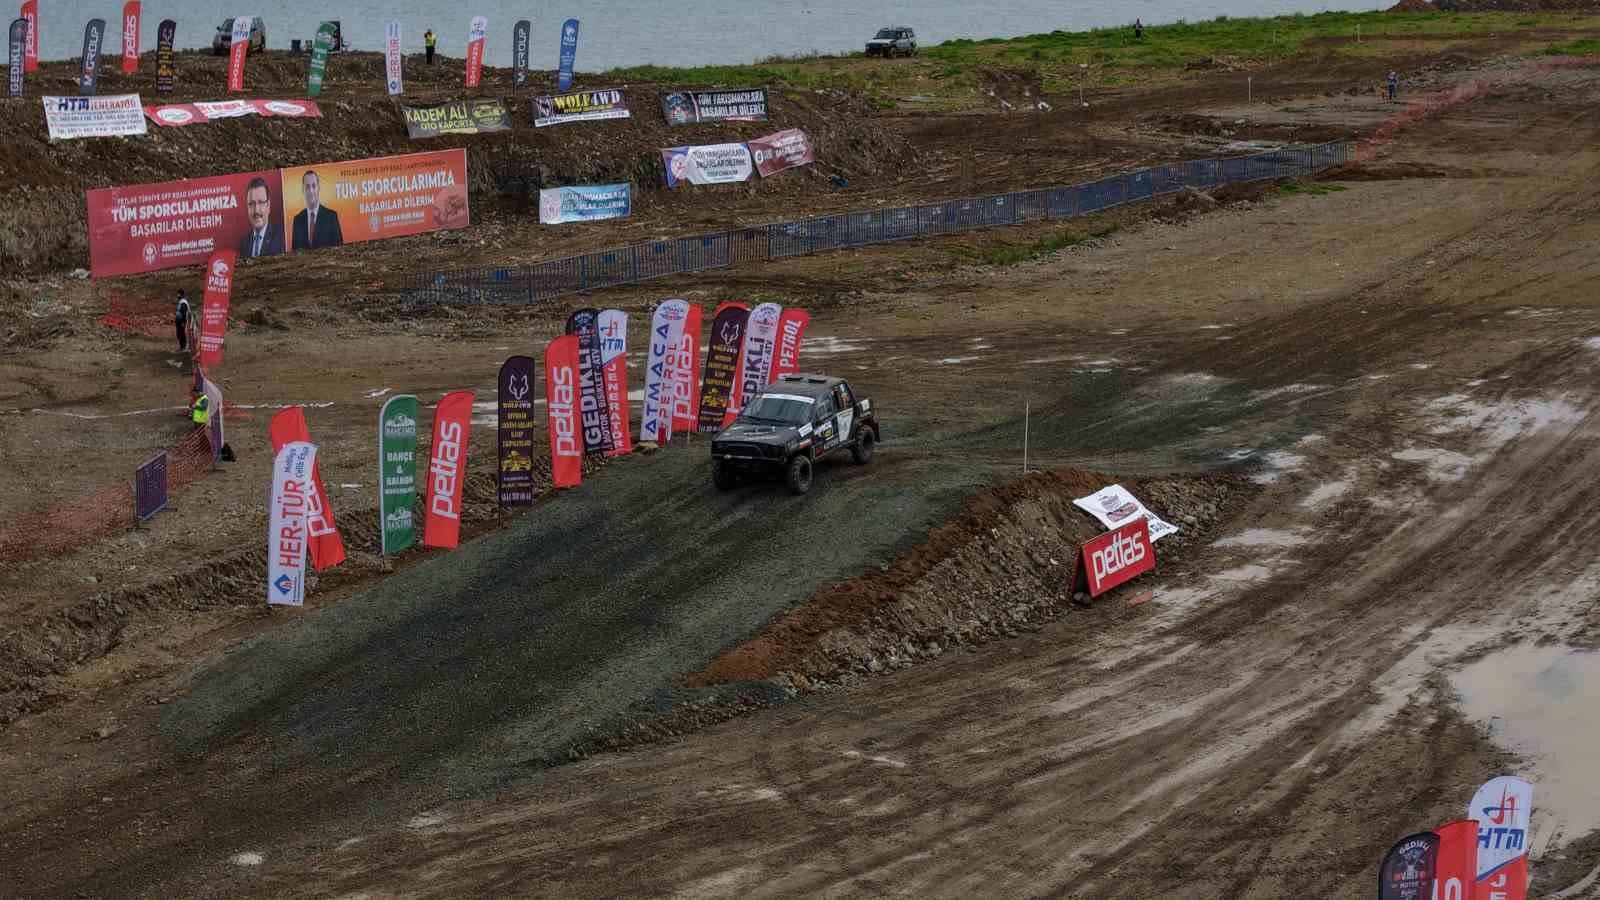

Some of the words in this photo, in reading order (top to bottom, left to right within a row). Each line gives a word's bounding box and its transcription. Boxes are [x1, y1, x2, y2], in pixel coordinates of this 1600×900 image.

[124, 15, 137, 59] petlas
[59, 98, 89, 111] HTM
[405, 108, 447, 122] KADEM
[420, 122, 437, 130] OTO
[336, 178, 359, 199] TÜM
[361, 169, 455, 197] SPORCULARIMIZA
[112, 204, 137, 222] TÜM
[139, 195, 238, 220] SPORCULARIMIZA
[360, 199, 403, 215] BAŞARILAR
[404, 193, 434, 209] DİLERİM
[131, 218, 185, 237] BAŞARILAR
[186, 213, 222, 230] DİLERİM
[779, 319, 803, 368] PETROL
[645, 323, 669, 434] ATMACA
[659, 343, 677, 417] PETROL
[550, 366, 581, 456] petlas
[431, 420, 462, 520] petlas
[277, 479, 306, 568] HER-TÜR
[1092, 531, 1145, 590] petlas
[1477, 827, 1525, 850] HTM
